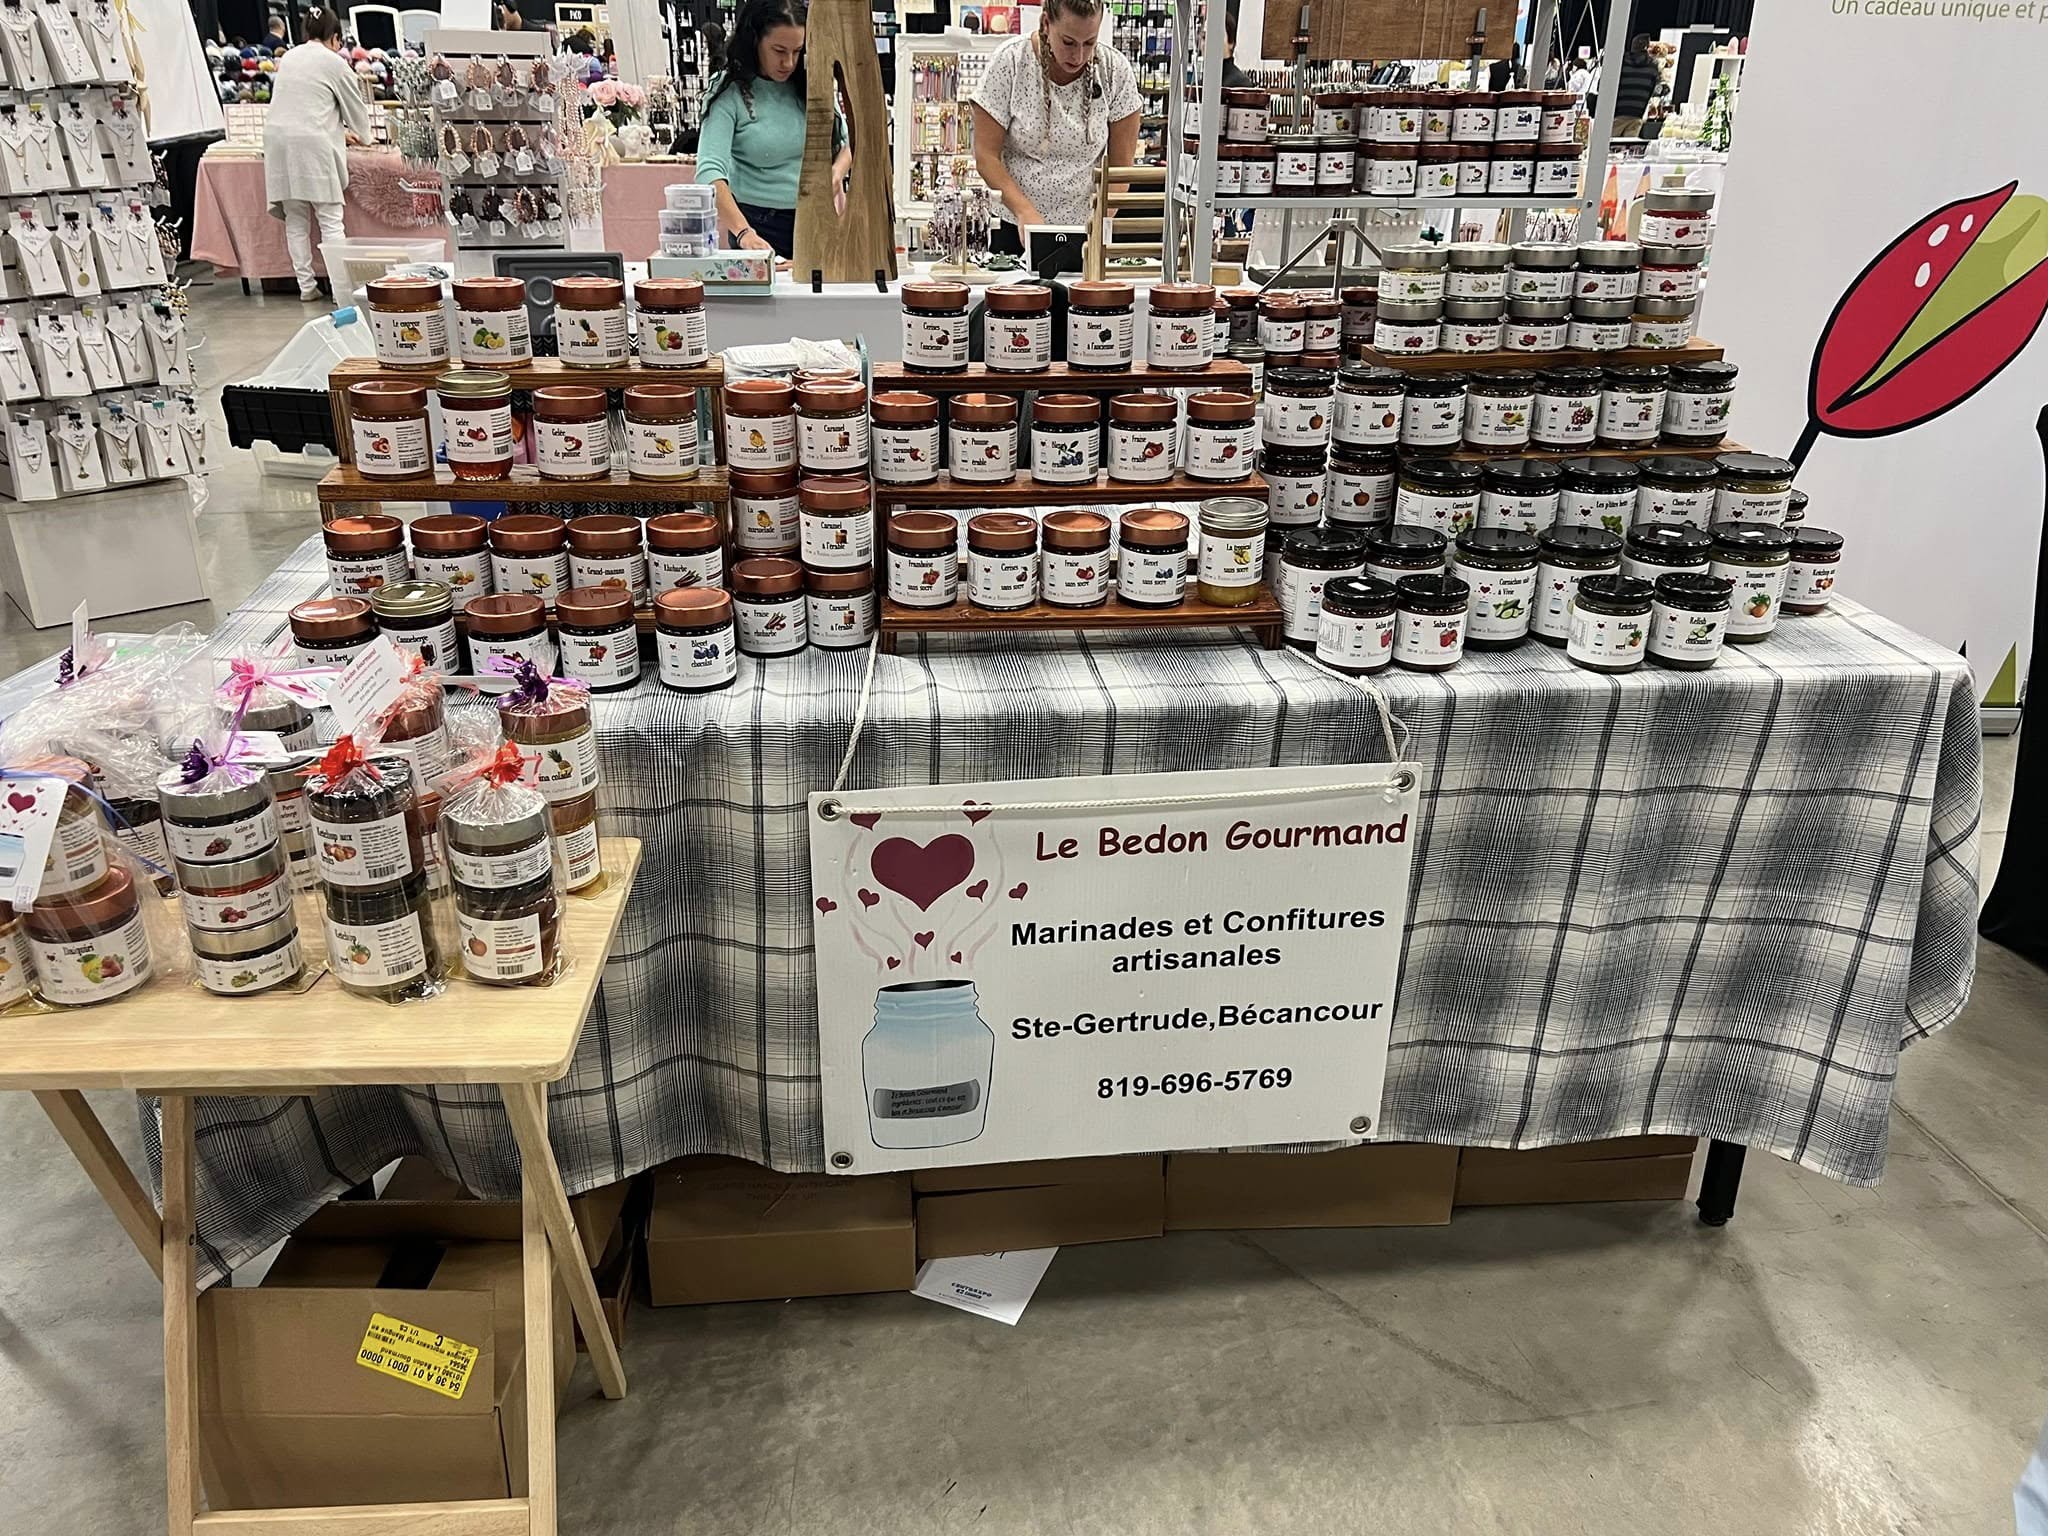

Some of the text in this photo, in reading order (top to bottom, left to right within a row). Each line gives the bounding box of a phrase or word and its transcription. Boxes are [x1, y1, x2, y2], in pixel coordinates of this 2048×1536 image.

[1831, 0, 2034, 21] Un cadeau unique et
[1036, 814, 1409, 861] Le Bedon Gourmand
[1011, 906, 1386, 946] Marinades et Confitures
[1112, 945, 1282, 974] artisanales
[1011, 1001, 1383, 1040] Ste-Gertrude,Bécancour
[1097, 1067, 1293, 1100] 819-696-5769
